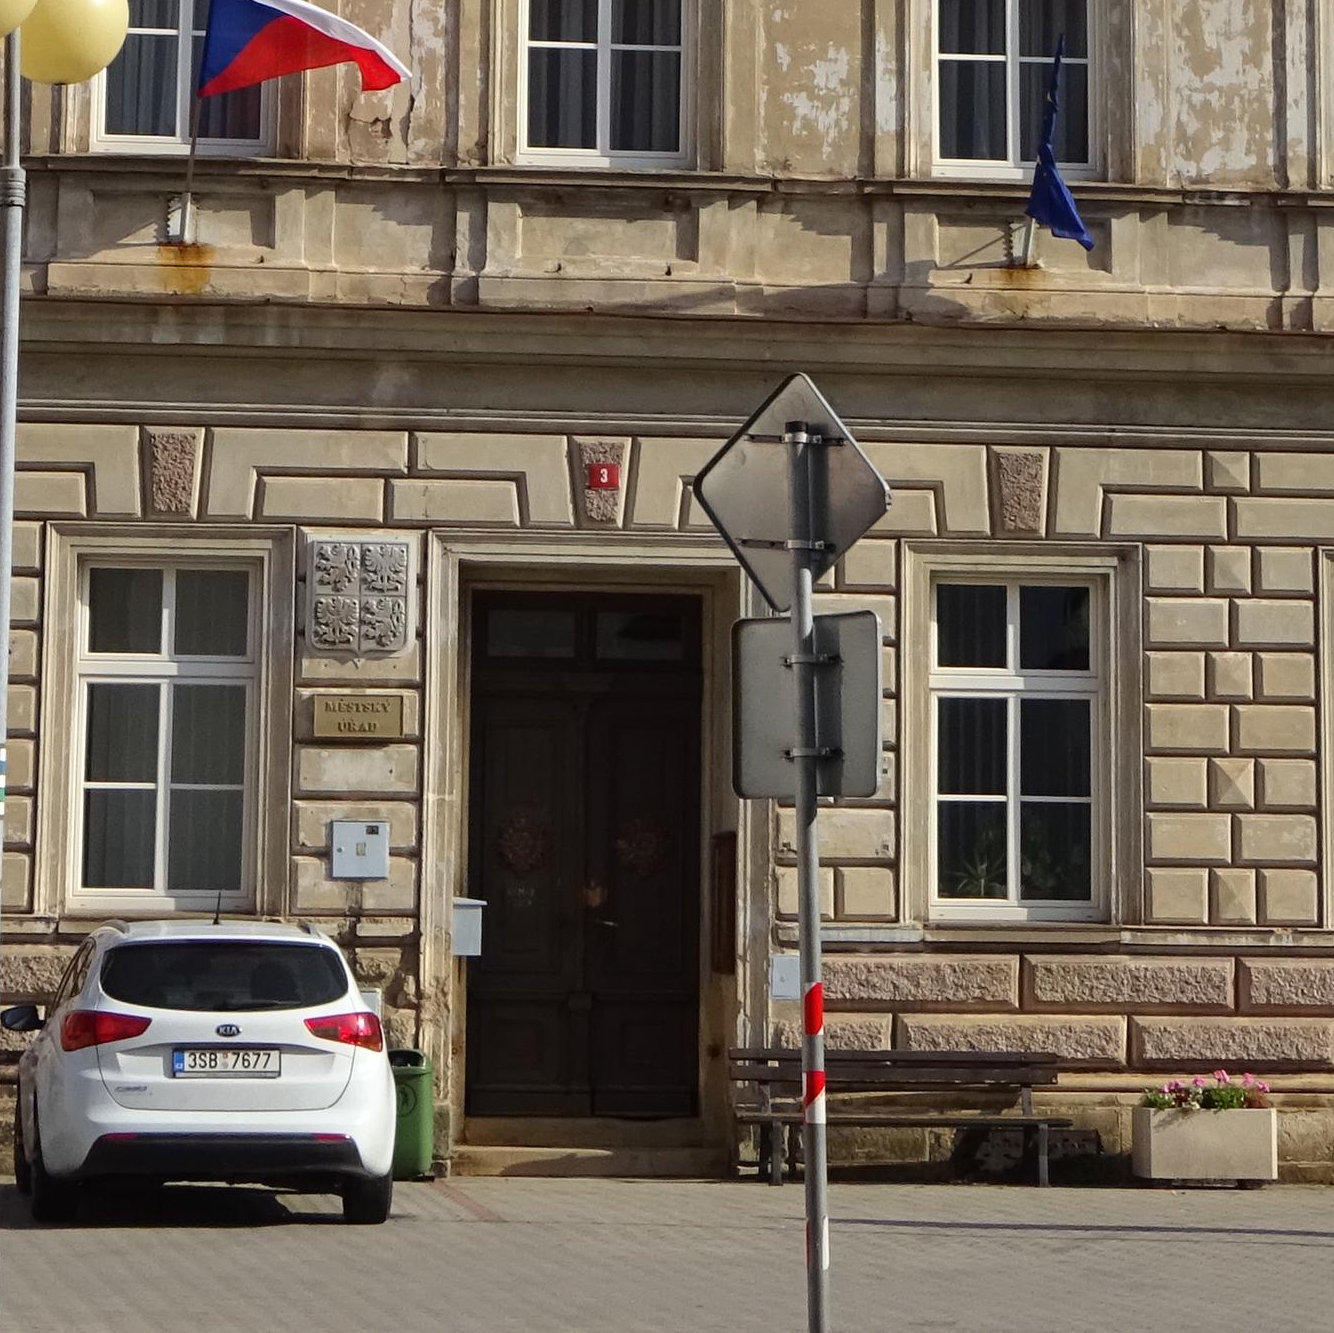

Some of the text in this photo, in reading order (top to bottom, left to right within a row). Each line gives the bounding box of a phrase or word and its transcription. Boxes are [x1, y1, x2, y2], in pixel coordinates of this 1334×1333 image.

[600, 468, 608, 483] 3
[324, 698, 391, 713] MĚSTSKÝ
[337, 717, 377, 733] ÚŘAD
[188, 1051, 272, 1070] 3SB 7677
